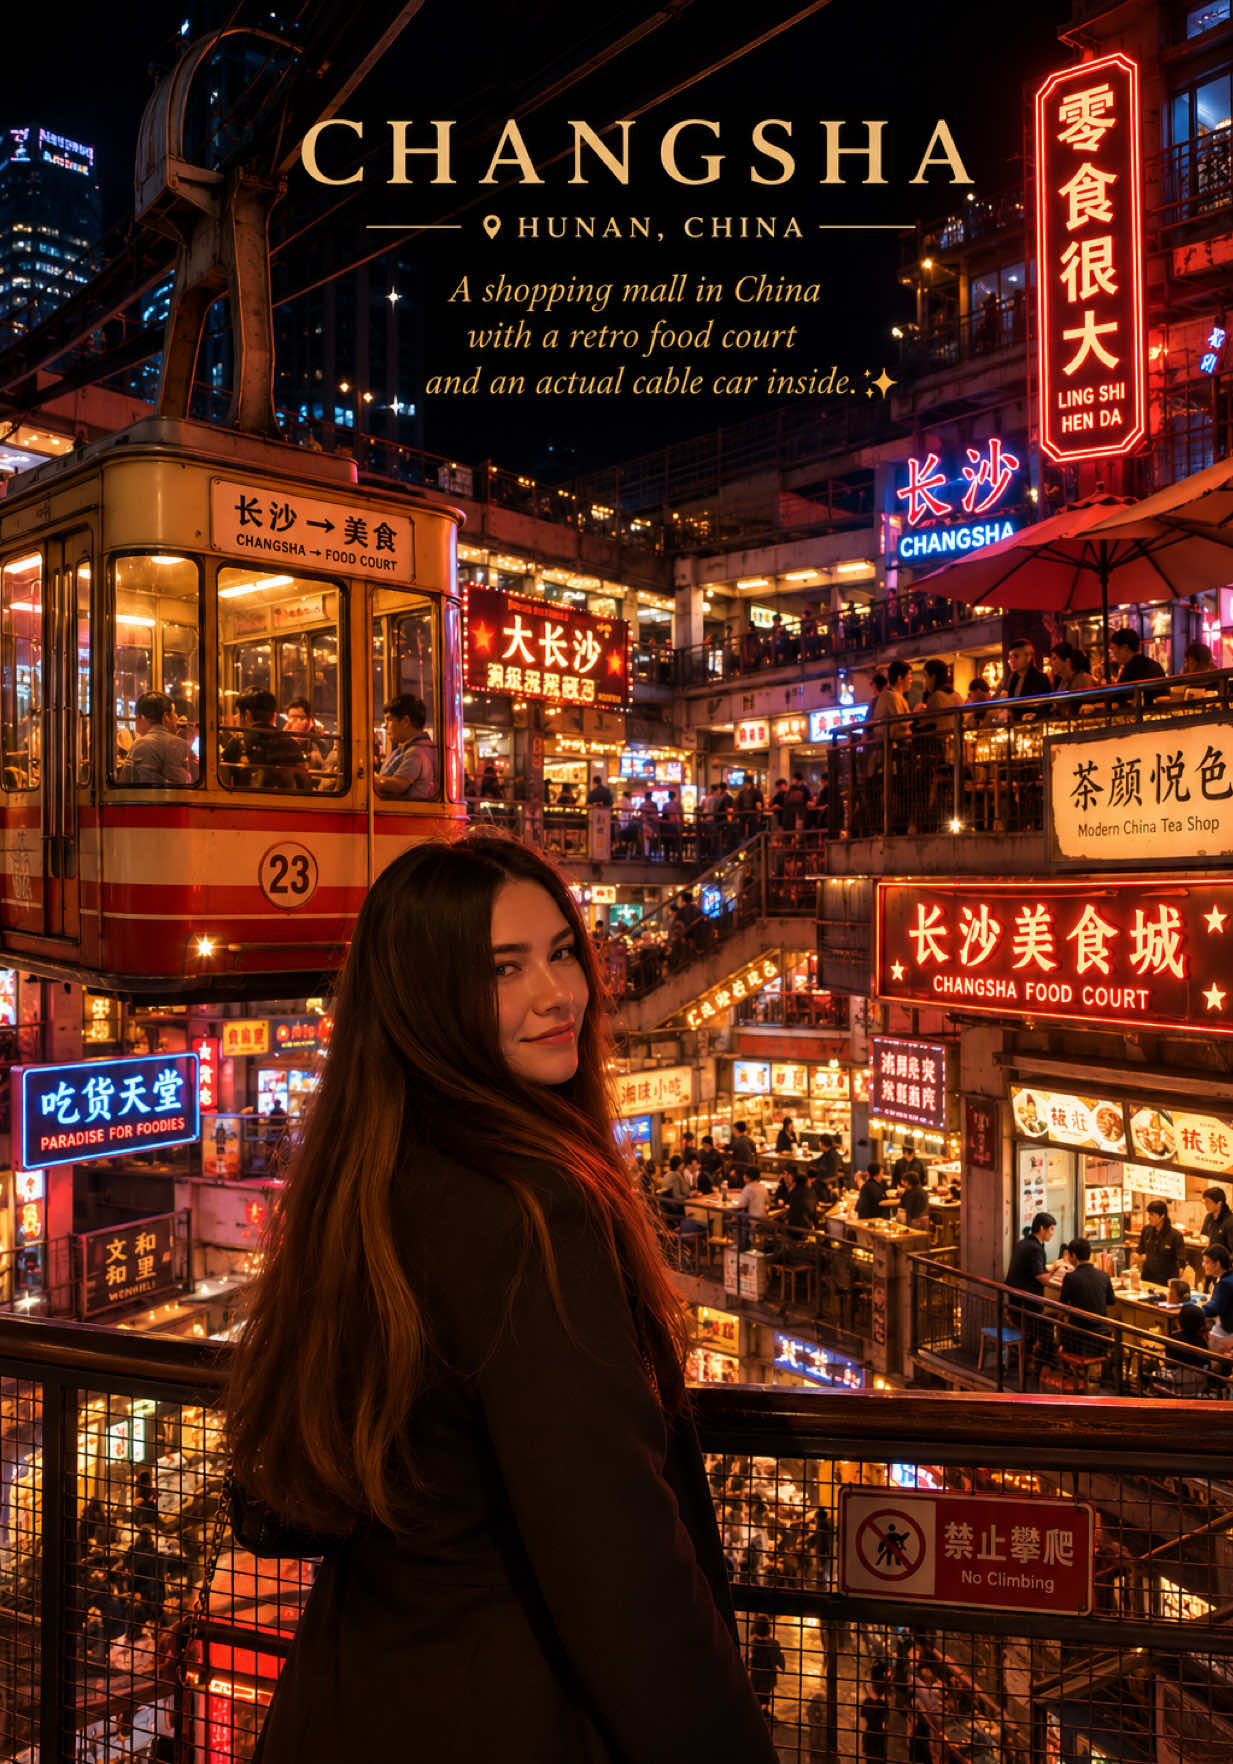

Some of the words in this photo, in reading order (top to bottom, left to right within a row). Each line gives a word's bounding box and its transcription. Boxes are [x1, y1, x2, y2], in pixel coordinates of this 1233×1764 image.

[1057, 83, 1120, 376] 零食很大
[1058, 387, 1095, 409] LING
[1099, 382, 1126, 402] SHI
[1062, 411, 1094, 433] HEN
[1100, 408, 1123, 427] DA
[896, 438, 1020, 526] 长沙
[234, 495, 298, 532] 长沙
[344, 515, 398, 553] 美食
[900, 521, 1014, 557] CHANGSHA
[236, 533, 306, 556] CHANGSHA
[325, 548, 356, 565] FOOD
[360, 554, 398, 571] COURT
[501, 614, 602, 674] 大长沙
[1070, 745, 1233, 812] 茶颜悦色
[1078, 821, 1120, 838] Modern
[1123, 818, 1157, 835] China
[1160, 818, 1183, 833] Tea
[1187, 815, 1220, 834] Shop
[269, 853, 310, 895] 23
[908, 902, 1185, 980] 长沙美食城
[933, 975, 1017, 999] CHANGSHA
[1025, 982, 1073, 1003] FOOD
[1082, 986, 1149, 1010] COURT
[41, 1068, 184, 1125] 吃货天堂
[41, 1128, 105, 1152] PARADISE
[109, 1124, 133, 1142] FOR
[136, 1116, 185, 1137] FOODIES
[943, 1521, 1074, 1568] 禁止攀爬
[961, 1570, 982, 1585] No
[987, 1571, 1055, 1594] Climbing
